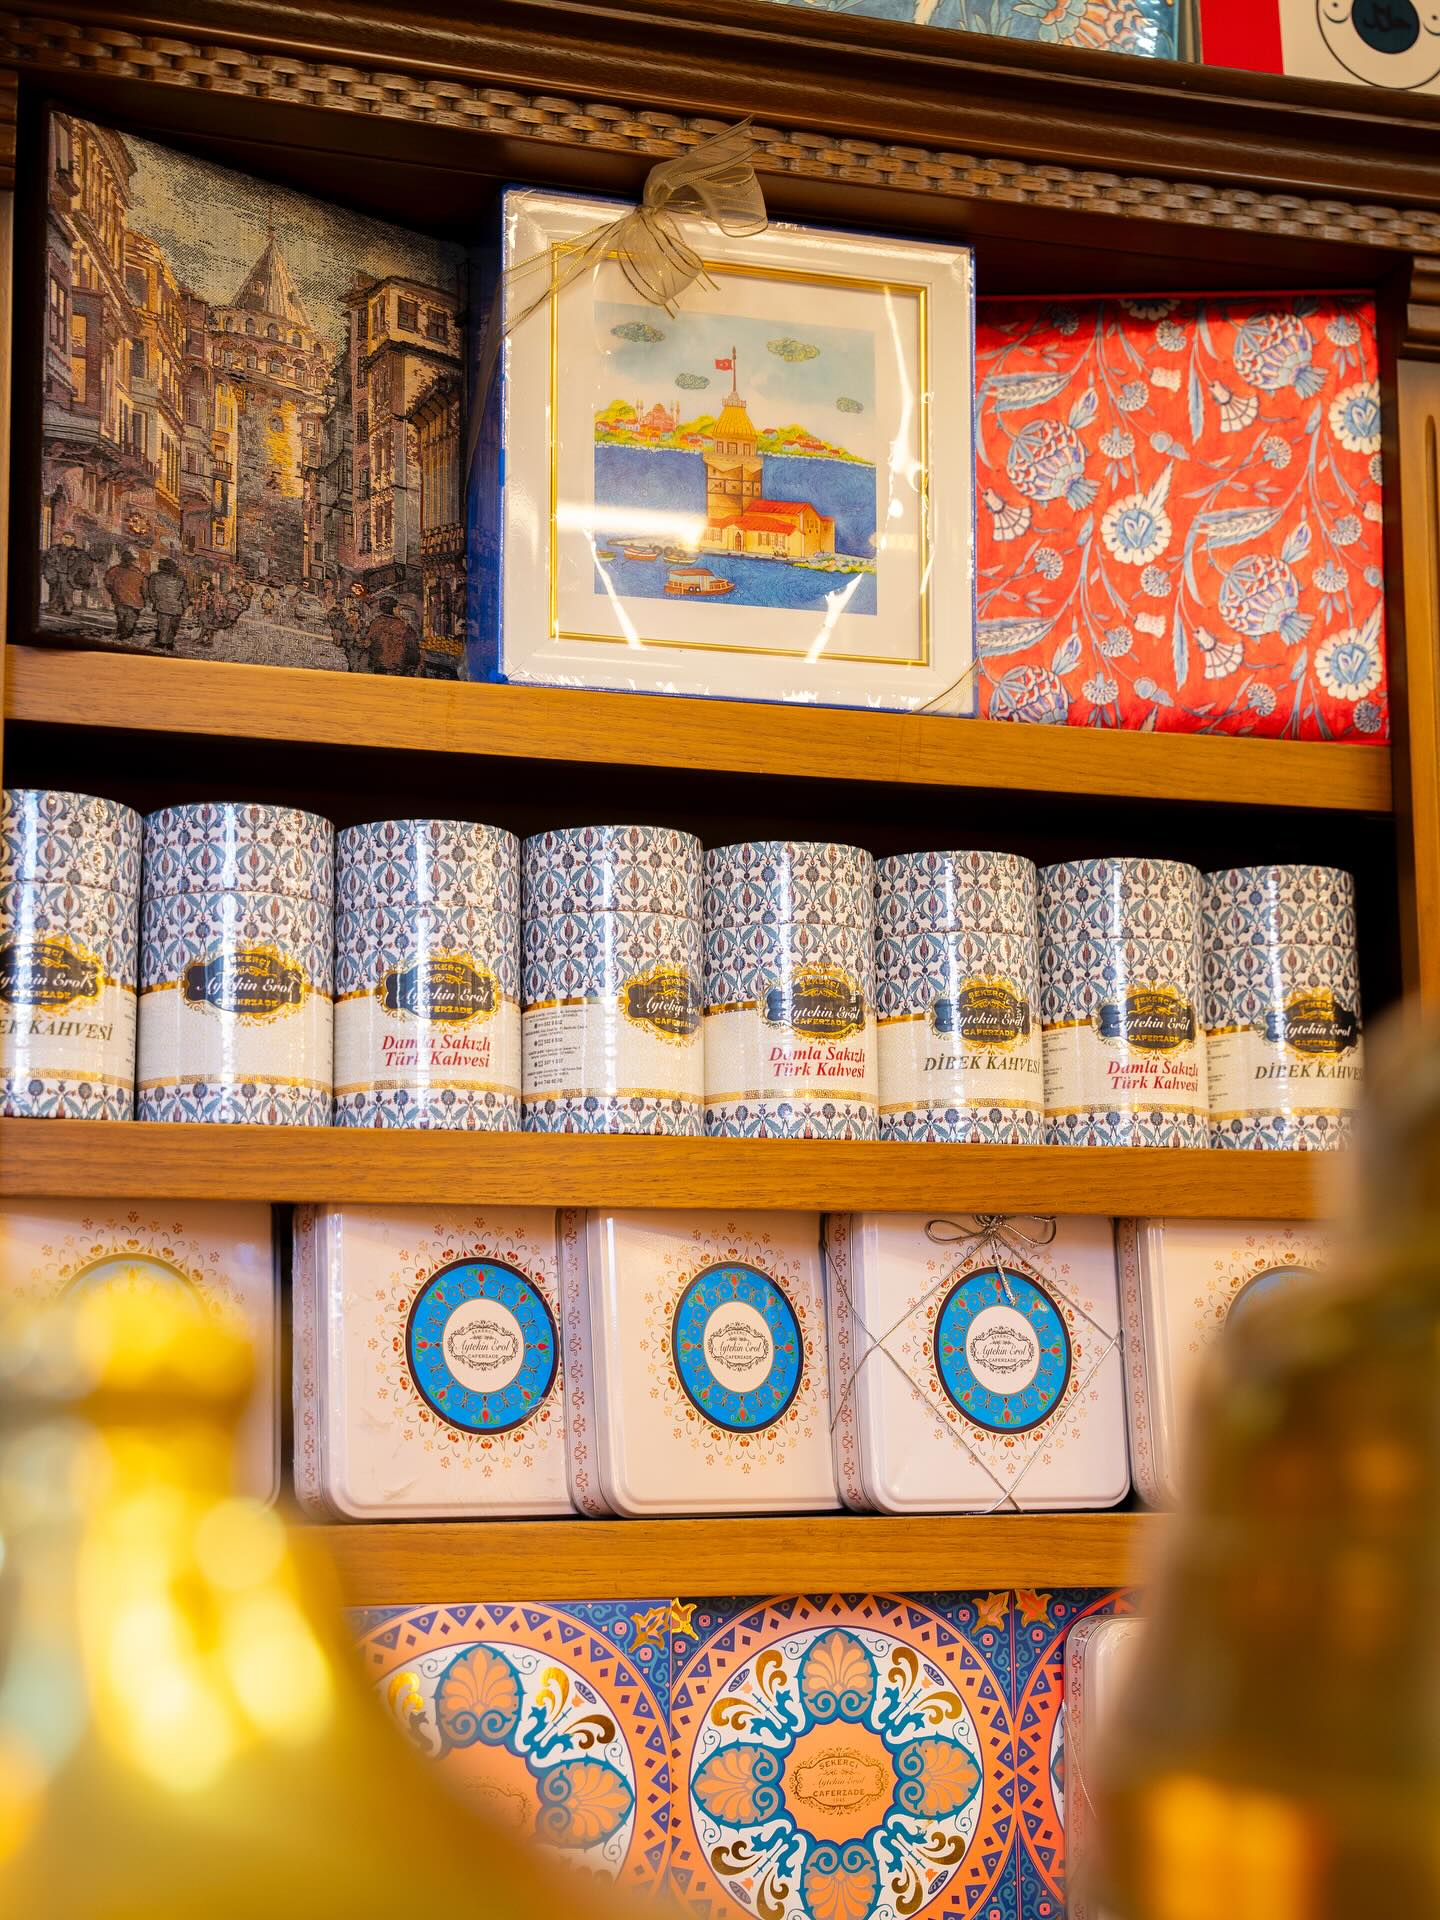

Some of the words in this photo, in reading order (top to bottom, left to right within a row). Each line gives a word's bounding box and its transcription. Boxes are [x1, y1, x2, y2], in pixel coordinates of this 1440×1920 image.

[460, 987, 491, 1004] Erol
[29, 1020, 113, 1041] KAHVESİ
[382, 1035, 435, 1051] Dama
[441, 1034, 491, 1052] Sakızlı
[431, 1051, 491, 1068] Kahvesi
[986, 1055, 1040, 1074] KAHVESİ
[1107, 1060, 1158, 1075] Damla
[774, 1062, 811, 1077] Türk
[816, 1062, 865, 1078] Kahvesi
[1316, 1065, 1363, 1081] KAHVE
[1111, 1075, 1147, 1090] Türk
[1152, 1075, 1199, 1093] Kahvesi
[813, 1789, 866, 1797] CAFERZADE
